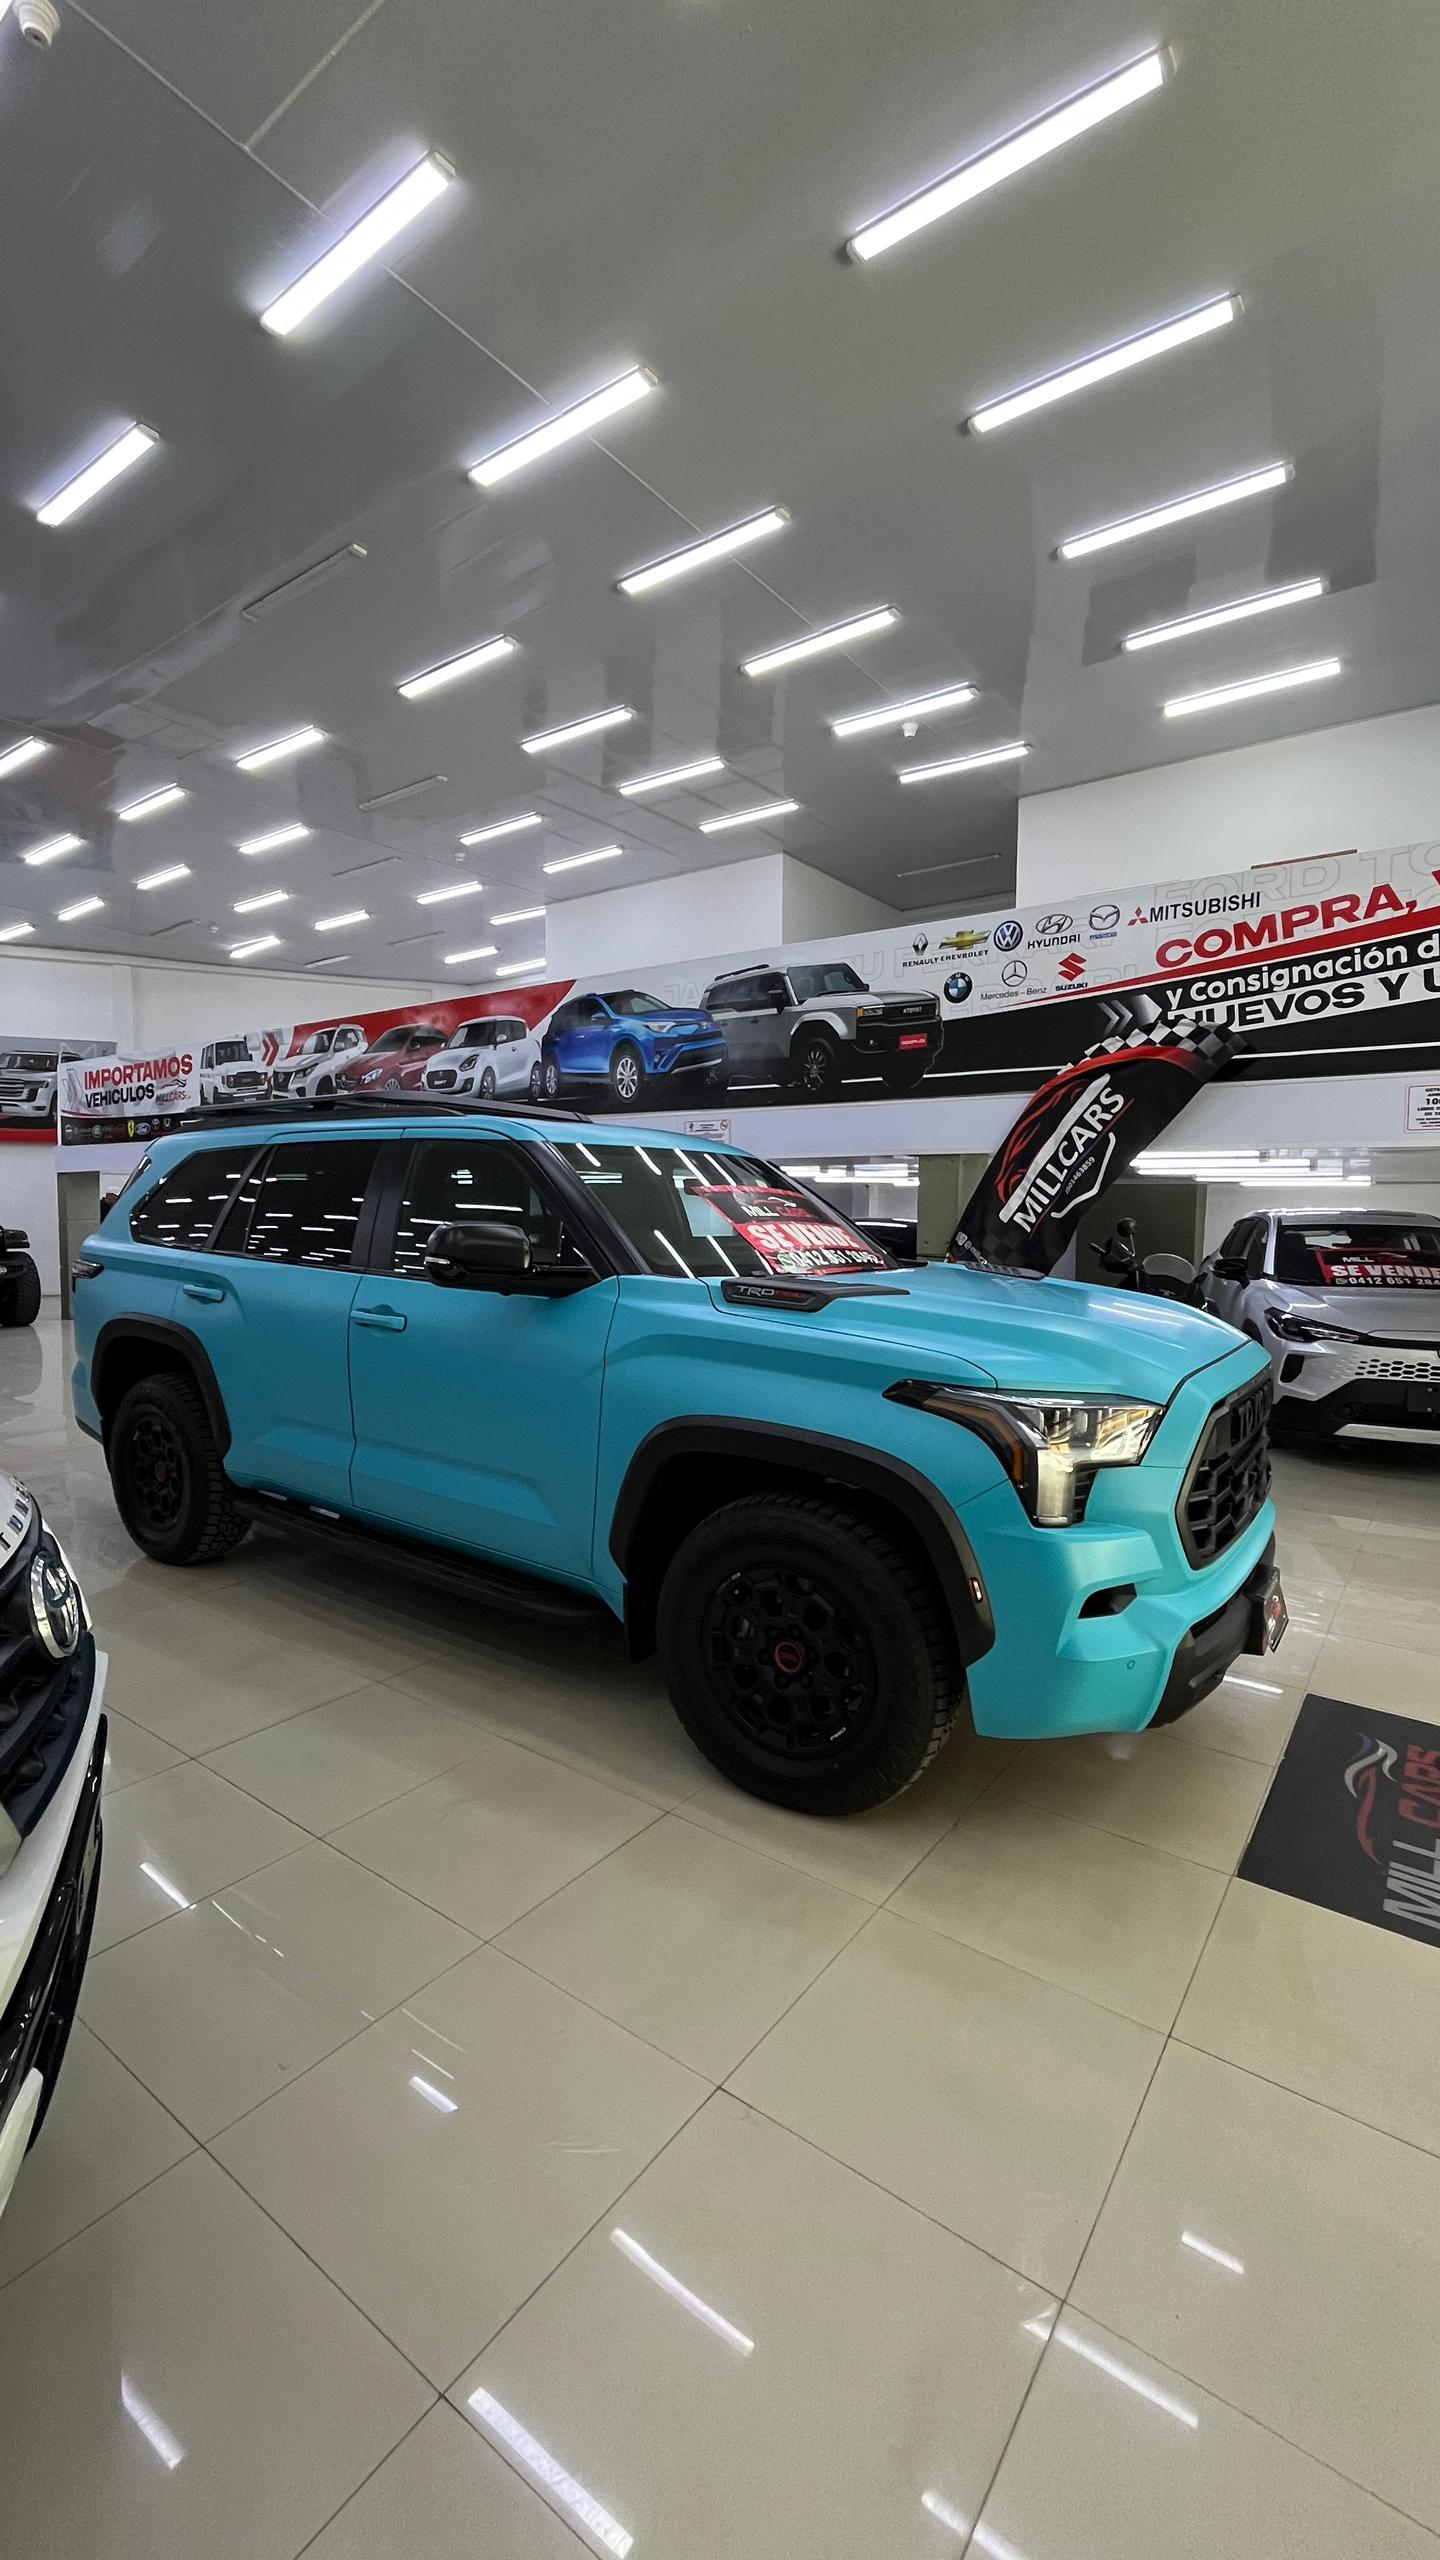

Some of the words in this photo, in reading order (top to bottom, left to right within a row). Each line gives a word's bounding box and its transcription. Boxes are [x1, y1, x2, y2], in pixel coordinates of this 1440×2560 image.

[1149, 891, 1261, 922] MITSUBISHI
[1156, 883, 1417, 968] COMPRA,
[1027, 934, 1081, 949] HYUNDAI
[902, 957, 939, 968] RENAULT
[940, 949, 989, 962] CHEVROLET
[1055, 982, 1088, 992] SUZUKI
[1166, 988, 1183, 1010] y
[1190, 944, 1407, 1001] consignación
[1172, 982, 1365, 1029] UEVOS
[1378, 973, 1410, 1000] Y
[84, 1054, 193, 1090] IMPORTAMOS
[85, 1083, 154, 1108] VEHICULOS
[1330, 1264, 1361, 1277] SE
[1364, 1265, 1440, 1279] VENDE
[1348, 1277, 1383, 1285] 0412
